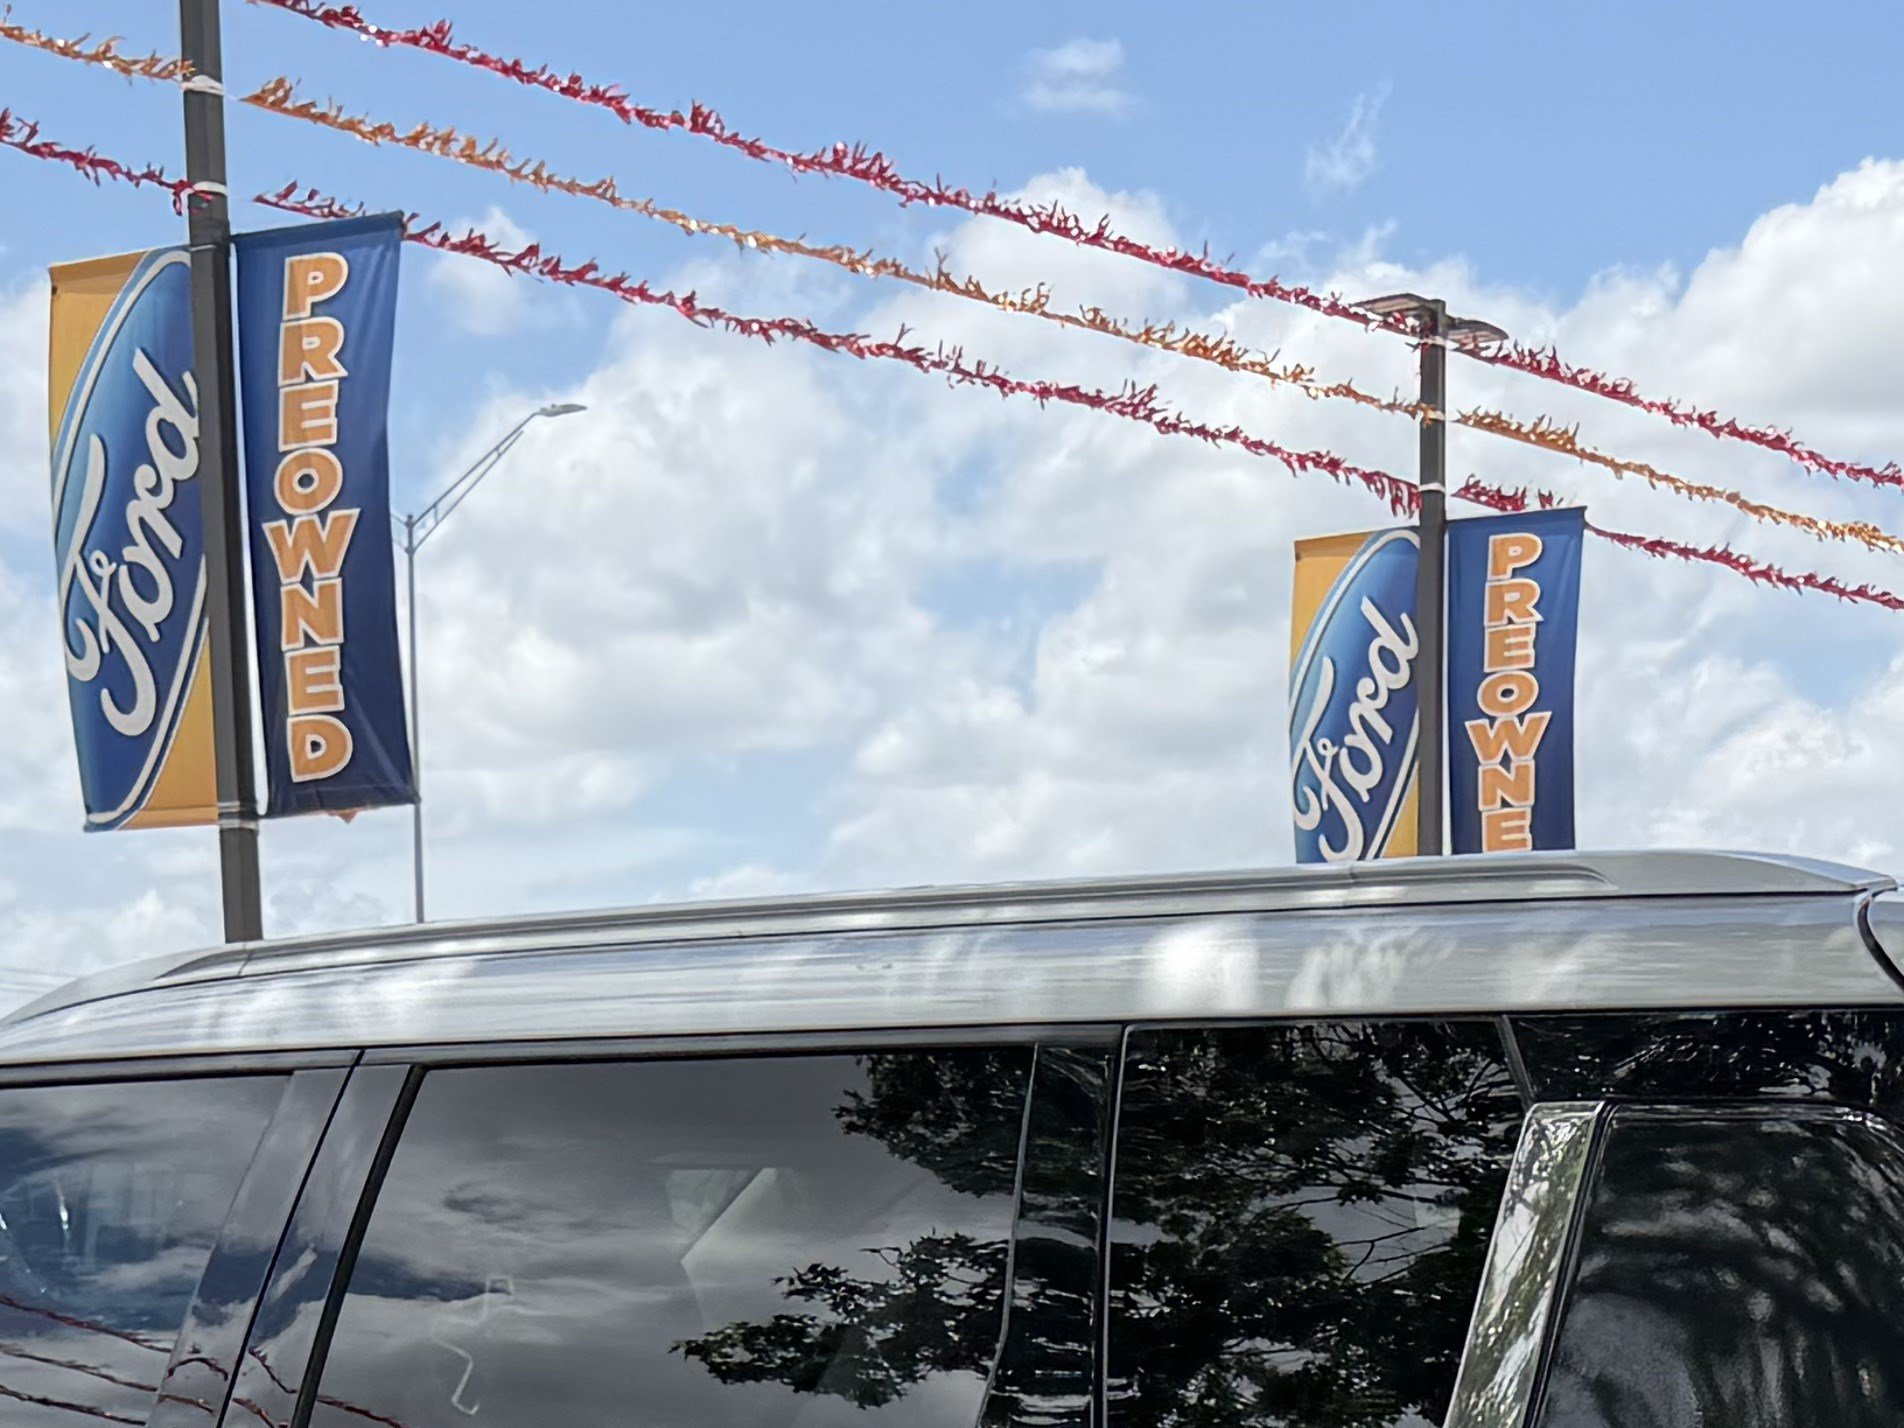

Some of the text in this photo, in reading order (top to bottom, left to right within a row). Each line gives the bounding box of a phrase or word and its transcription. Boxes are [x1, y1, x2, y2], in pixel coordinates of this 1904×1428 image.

[62, 347, 201, 737] Ford
[262, 251, 361, 783] PREOWNED
[1293, 597, 1419, 863] Ford
